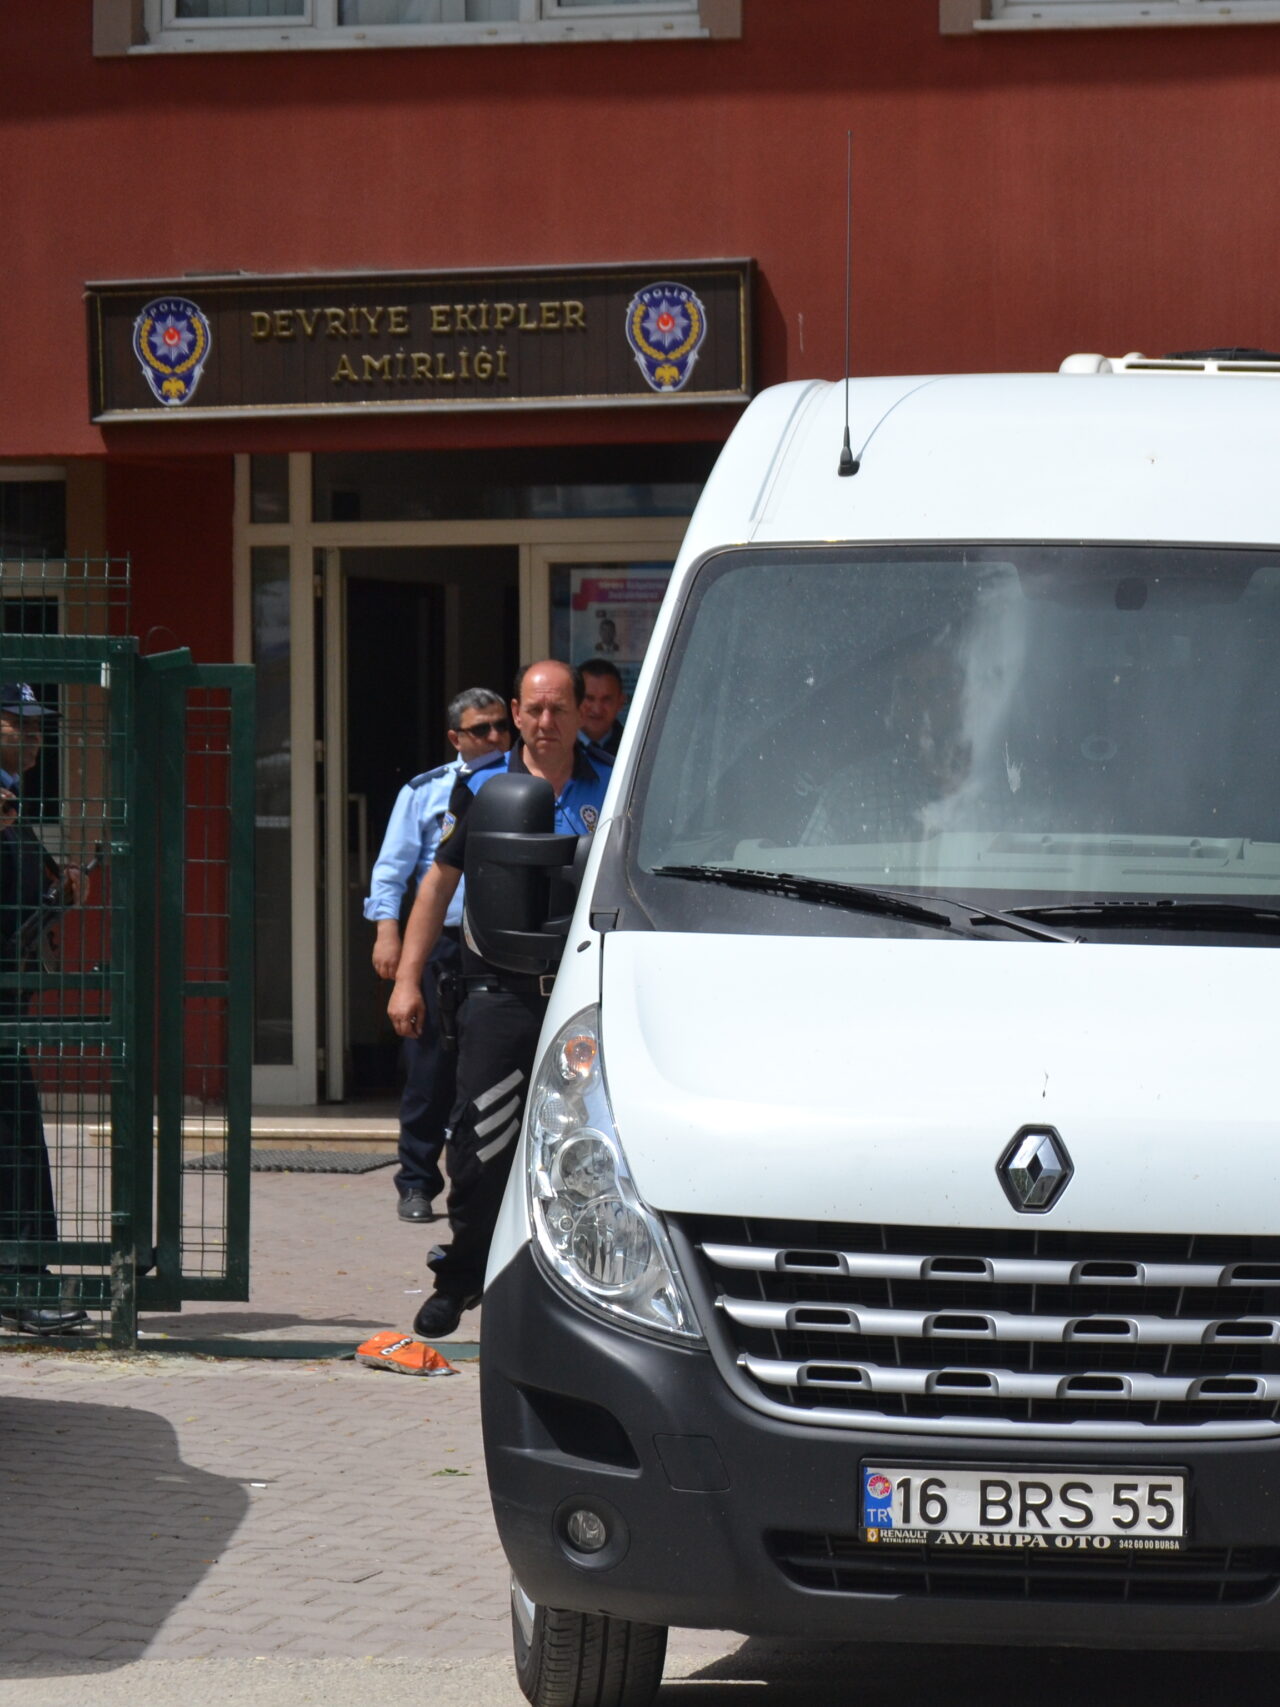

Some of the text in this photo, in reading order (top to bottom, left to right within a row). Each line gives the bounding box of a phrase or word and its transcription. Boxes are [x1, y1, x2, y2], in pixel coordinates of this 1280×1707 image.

[642, 287, 688, 303] POLİS
[250, 299, 586, 337] DEVRİYE EKİPLER
[330, 344, 507, 381] AMİRLİĞİ
[896, 1477, 1174, 1531] 16 BRS 55
[867, 1508, 888, 1523] TR
[880, 1529, 929, 1539] RENAULT
[935, 1531, 1112, 1549] AVRUPA OTO
[1119, 1539, 1133, 1549] 342
[1155, 1540, 1180, 1550] BURSA
